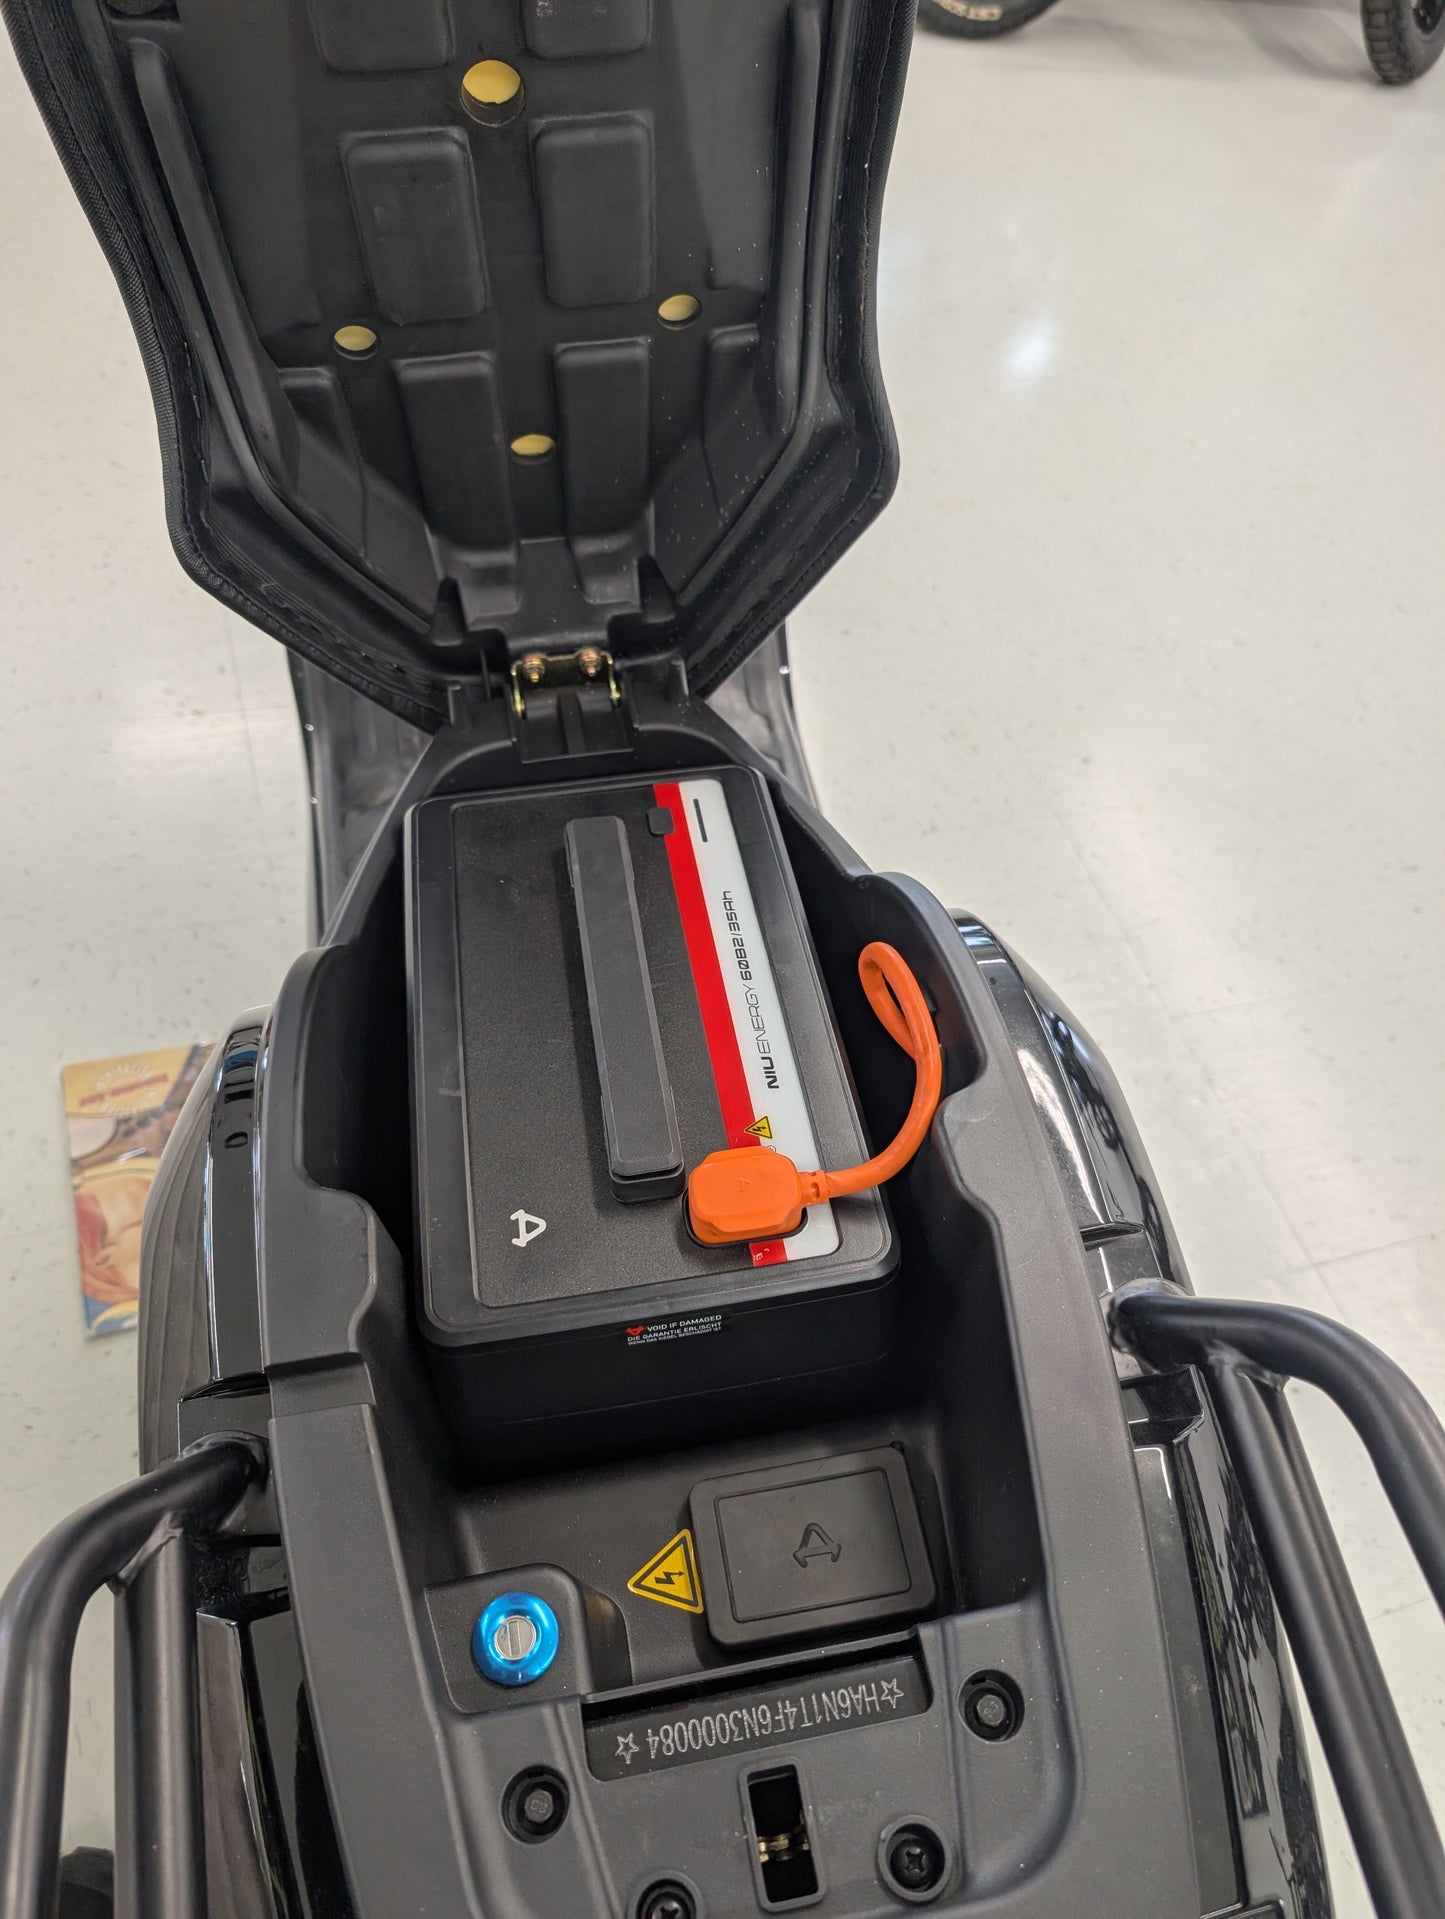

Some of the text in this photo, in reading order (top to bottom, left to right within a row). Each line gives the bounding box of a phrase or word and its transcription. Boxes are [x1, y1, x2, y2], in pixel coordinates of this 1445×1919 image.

[742, 983, 771, 1054] ENERGY
[761, 1056, 779, 1089] NIU
[642, 1328, 681, 1340] GARANTIE
[683, 1321, 722, 1333] ERLISCHT
[647, 1314, 722, 1332] VOID IF DAMAGED
[646, 1682, 881, 1760] HA6N1T4F6N3000084
